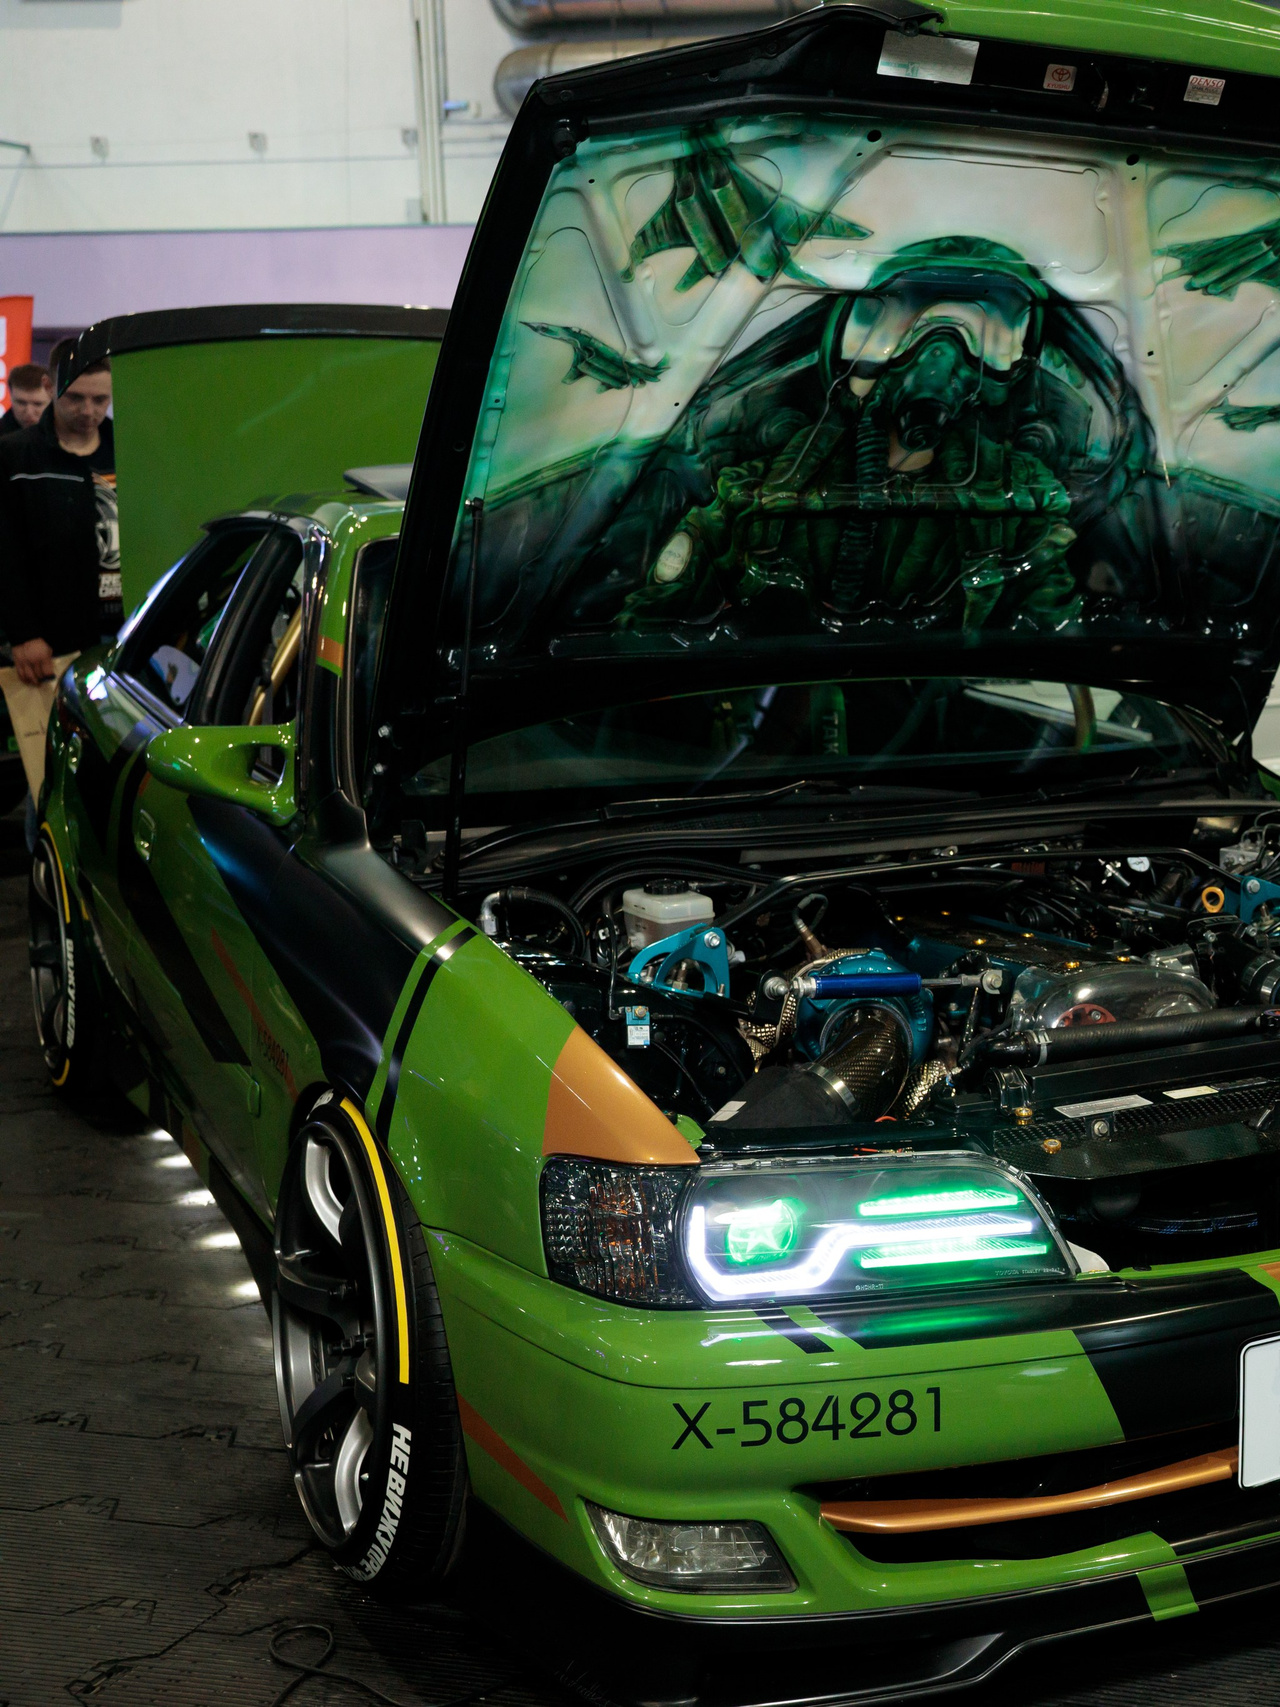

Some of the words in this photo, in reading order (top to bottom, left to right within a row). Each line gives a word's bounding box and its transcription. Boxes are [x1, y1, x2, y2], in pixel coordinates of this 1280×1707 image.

[1190, 77, 1223, 88] DENSO
[671, 1387, 941, 1450] X-584281
[390, 1422, 412, 1475] НЕ
[375, 1467, 406, 1555] ВИЖУ
